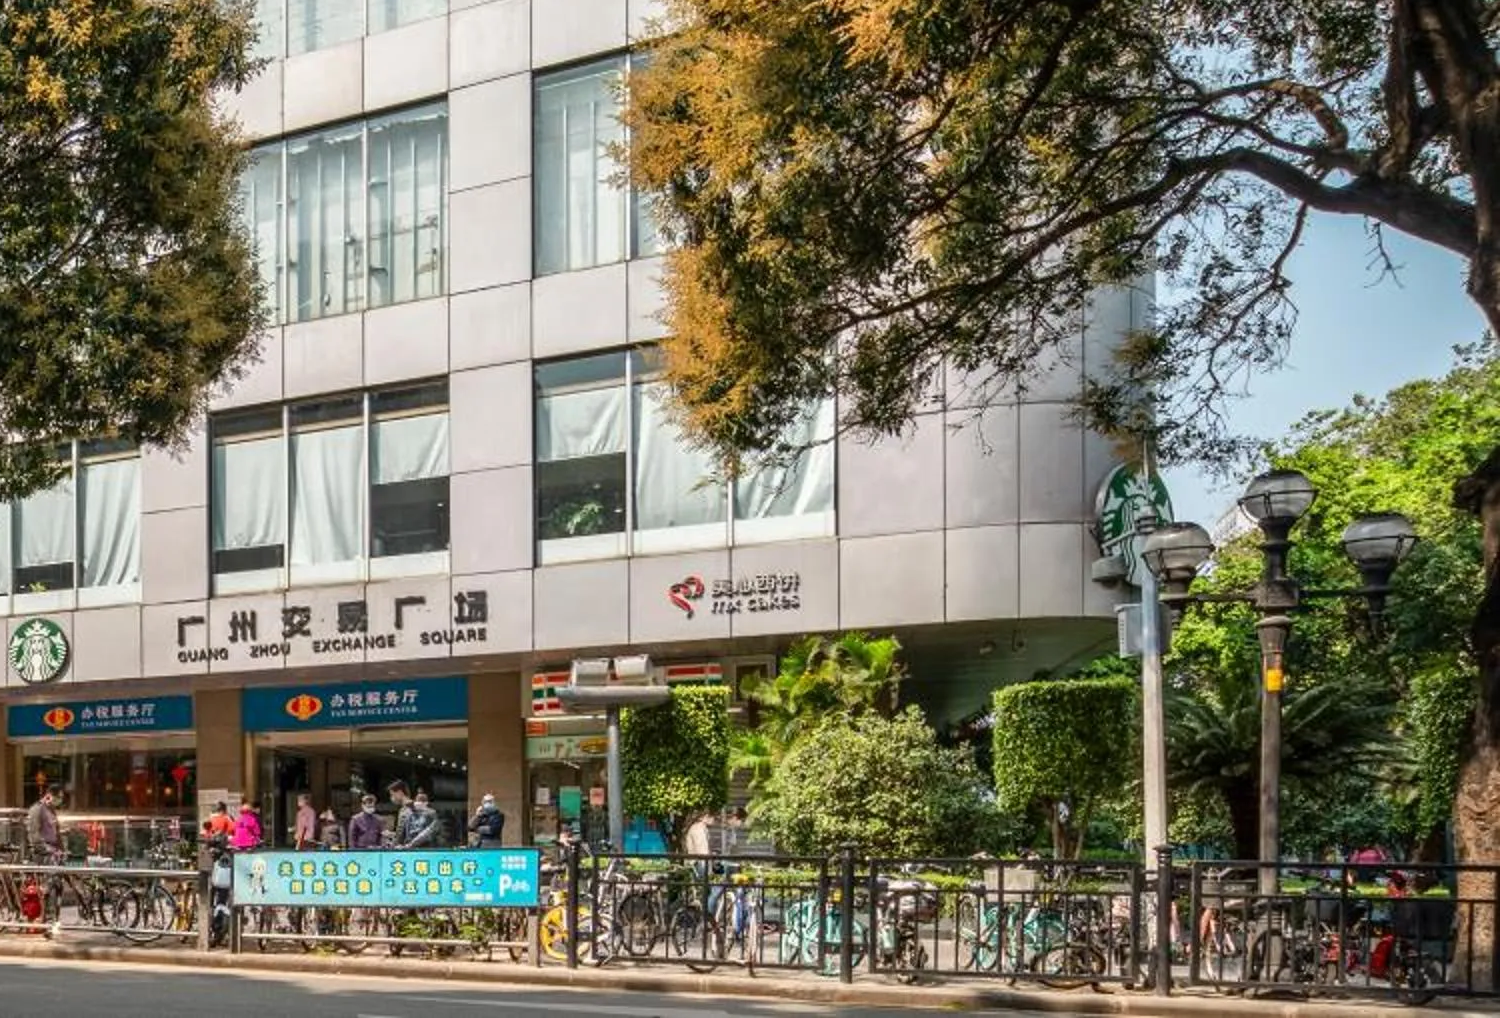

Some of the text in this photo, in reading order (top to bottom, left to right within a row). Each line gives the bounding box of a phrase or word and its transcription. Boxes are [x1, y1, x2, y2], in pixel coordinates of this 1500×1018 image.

[177, 590, 488, 647] 广州交易广场
[177, 627, 487, 663] GUANG ZHOU EXCHANGE SQUARE
[81, 703, 156, 720] 办税服务厅
[330, 688, 419, 708] 办税服务厅
